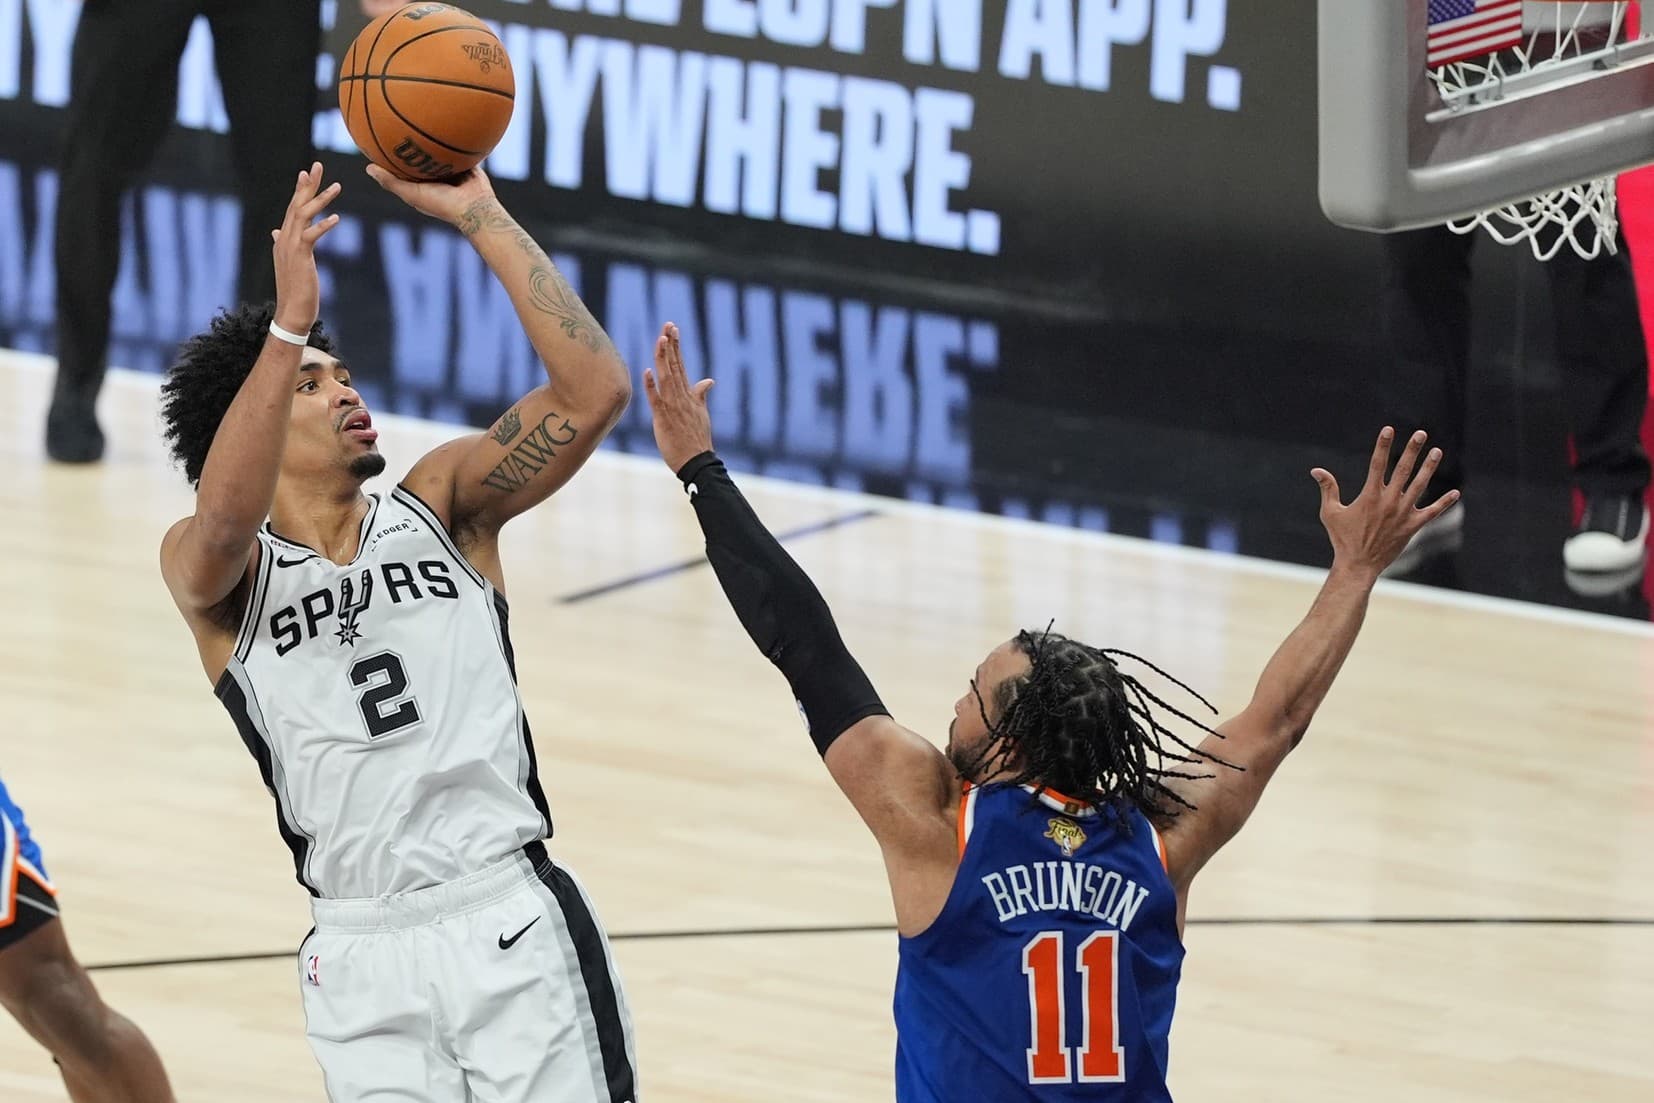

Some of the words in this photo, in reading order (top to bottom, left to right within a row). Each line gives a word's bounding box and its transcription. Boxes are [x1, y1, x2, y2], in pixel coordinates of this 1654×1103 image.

[997, 0, 1242, 112] APP.
[480, 20, 1000, 256] YWHERE.
[481, 412, 578, 493] WAWG
[372, 523, 409, 544] LEDGER
[269, 560, 459, 657] SPURS
[347, 649, 424, 741] 2
[982, 861, 1149, 932] BRUNSON
[1022, 930, 1125, 1085] 11
